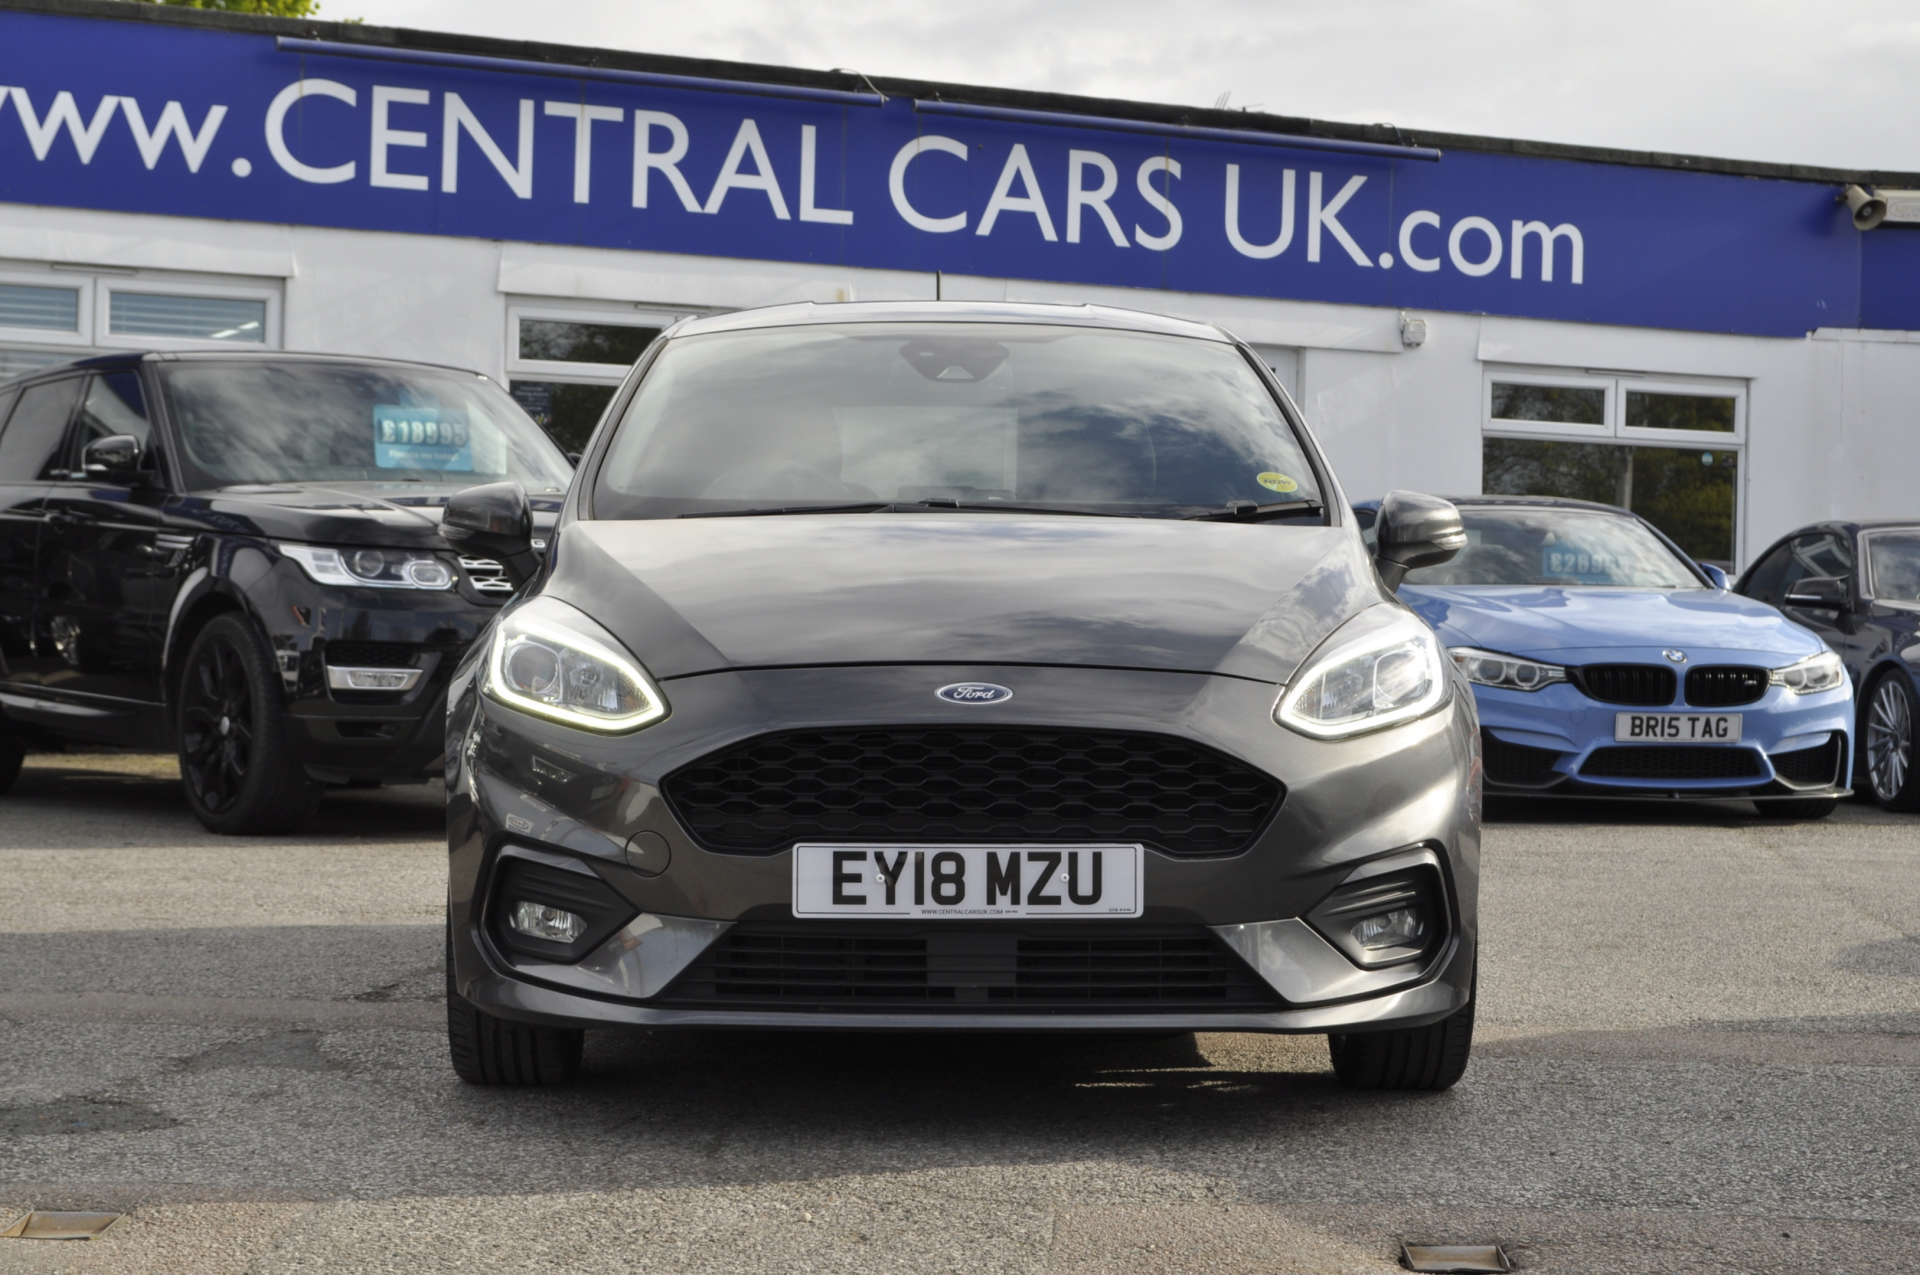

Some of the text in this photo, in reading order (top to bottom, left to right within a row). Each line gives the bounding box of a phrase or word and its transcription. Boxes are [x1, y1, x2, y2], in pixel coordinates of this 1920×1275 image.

[0, 79, 1583, 284] ww.CENTRAL CARS UK.com
[953, 686, 996, 699] Ford
[1630, 716, 1728, 738] BR15 TAG
[832, 850, 1103, 906] EY18 MZU
